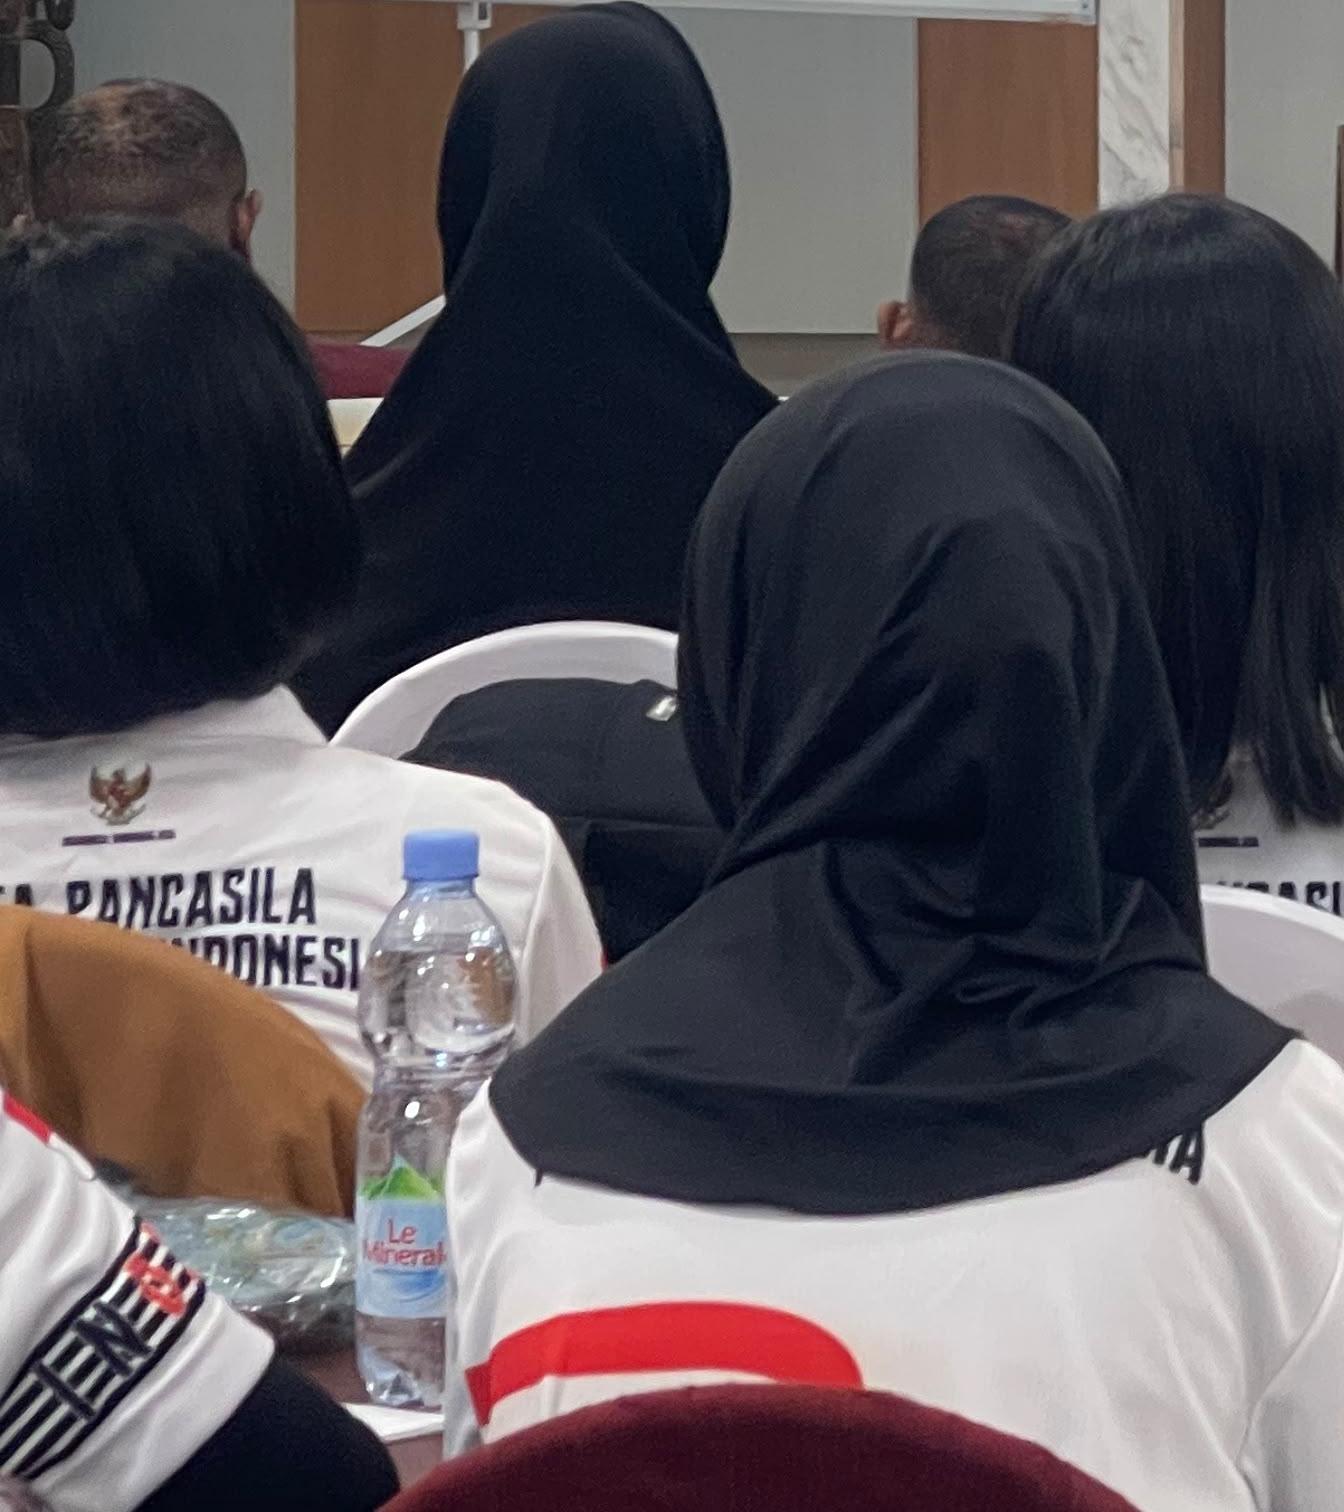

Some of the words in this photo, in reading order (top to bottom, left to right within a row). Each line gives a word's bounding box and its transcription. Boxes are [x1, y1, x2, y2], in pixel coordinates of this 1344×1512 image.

[65, 866, 317, 930] PANCASILA
[170, 933, 360, 991] DONESI
[387, 1217, 417, 1245] Le
